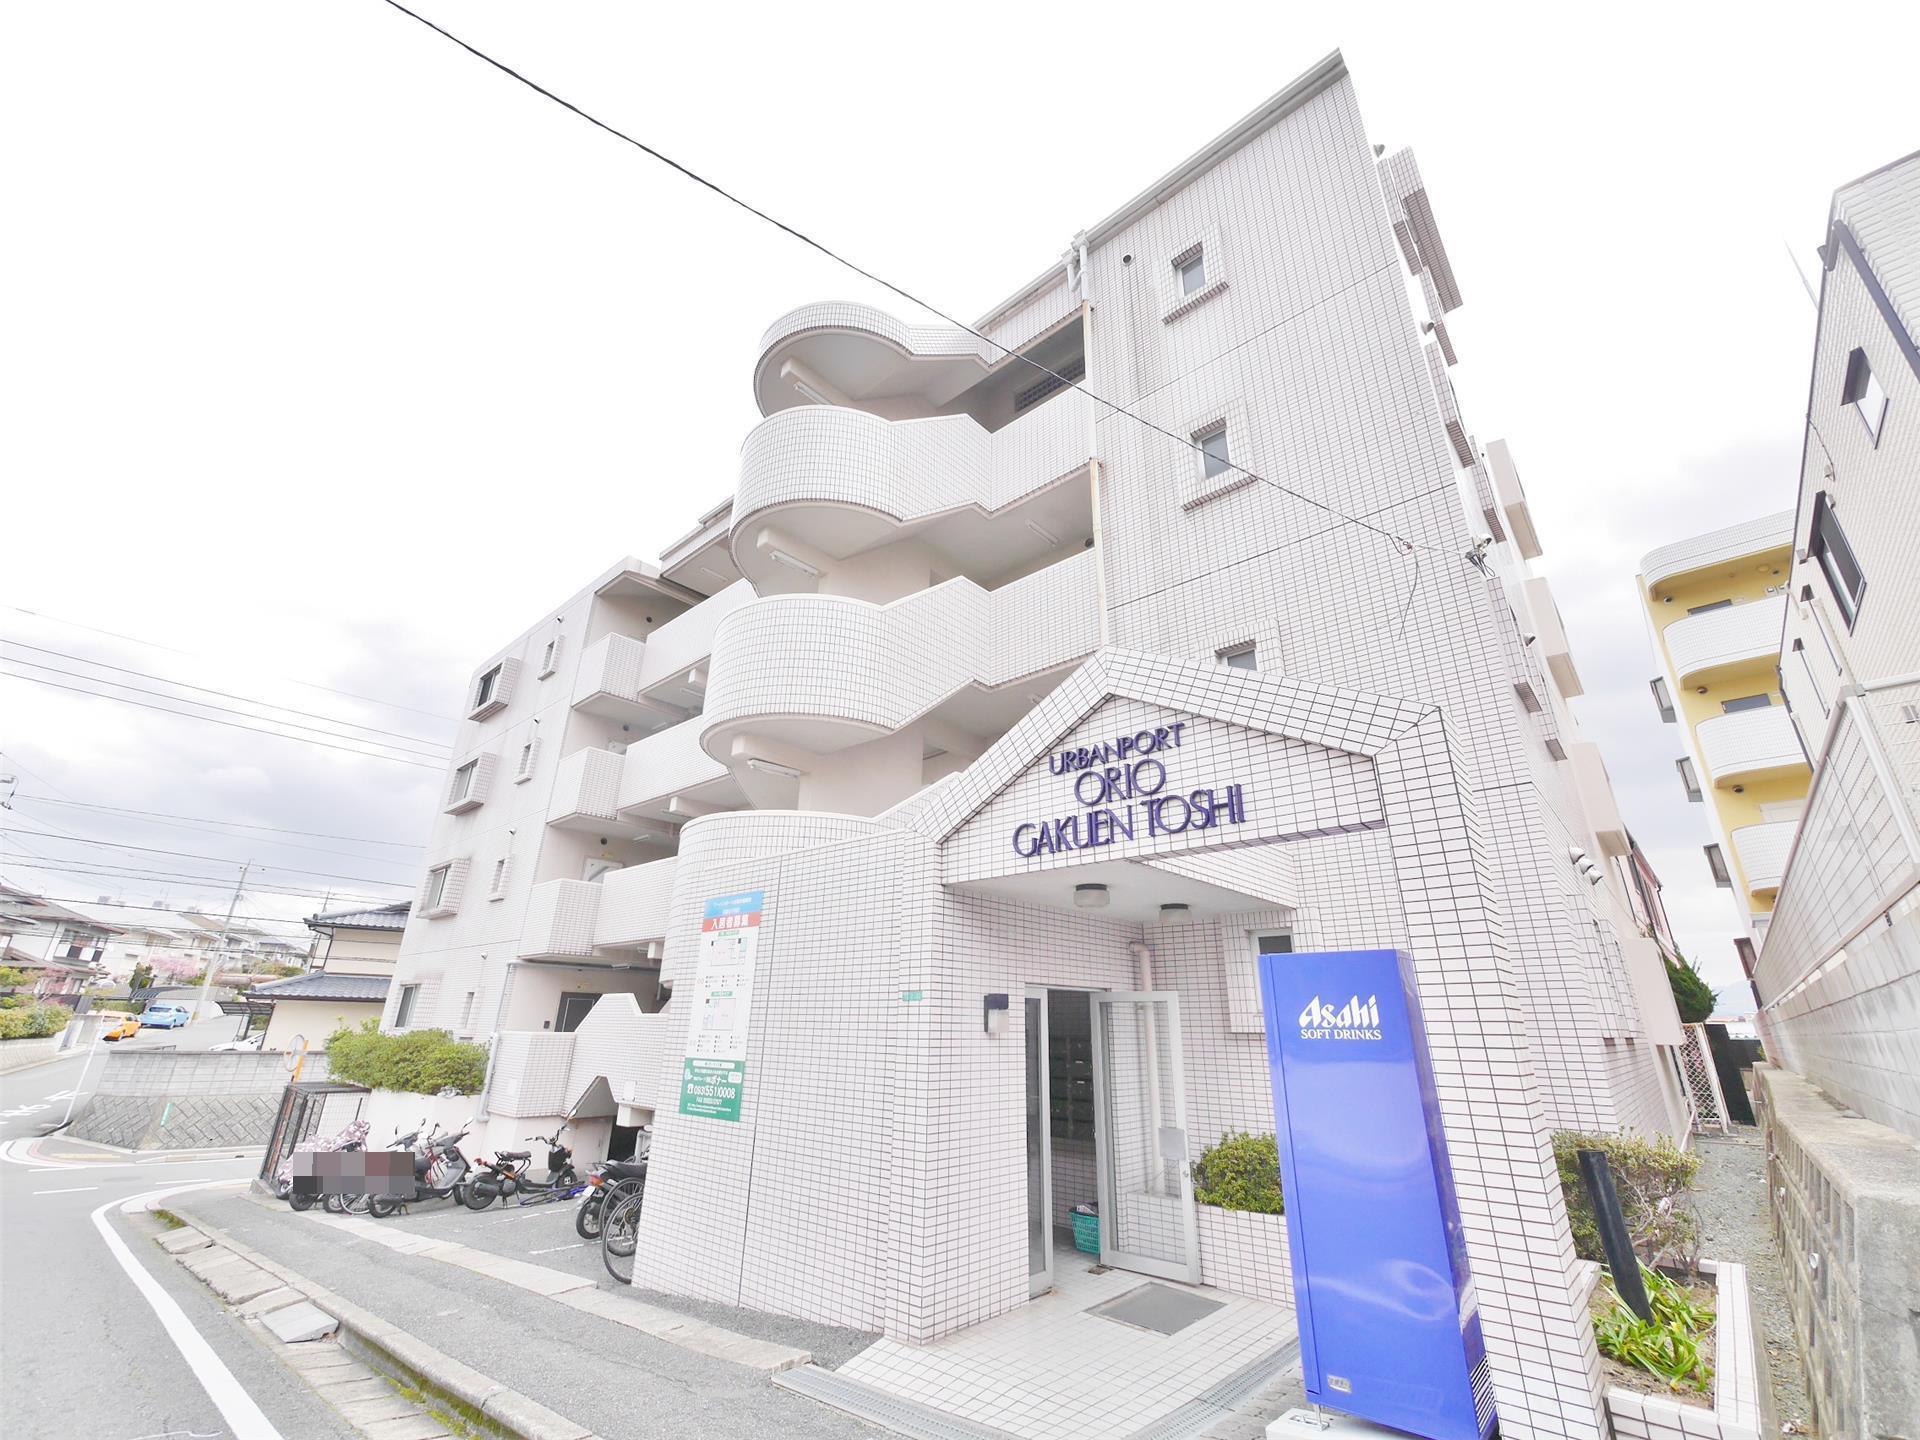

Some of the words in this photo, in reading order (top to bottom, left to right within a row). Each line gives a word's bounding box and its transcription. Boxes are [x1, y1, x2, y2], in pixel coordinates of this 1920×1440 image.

[1050, 722, 1184, 775] URBANPORT
[1074, 758, 1166, 806] ORIO
[1012, 805, 1133, 858] GAKUEN
[1140, 783, 1246, 837] TOSHI
[1299, 994, 1380, 1028] Asahi
[1300, 1028, 1331, 1040] SOFT
[1334, 1028, 1382, 1041] DRINKS
